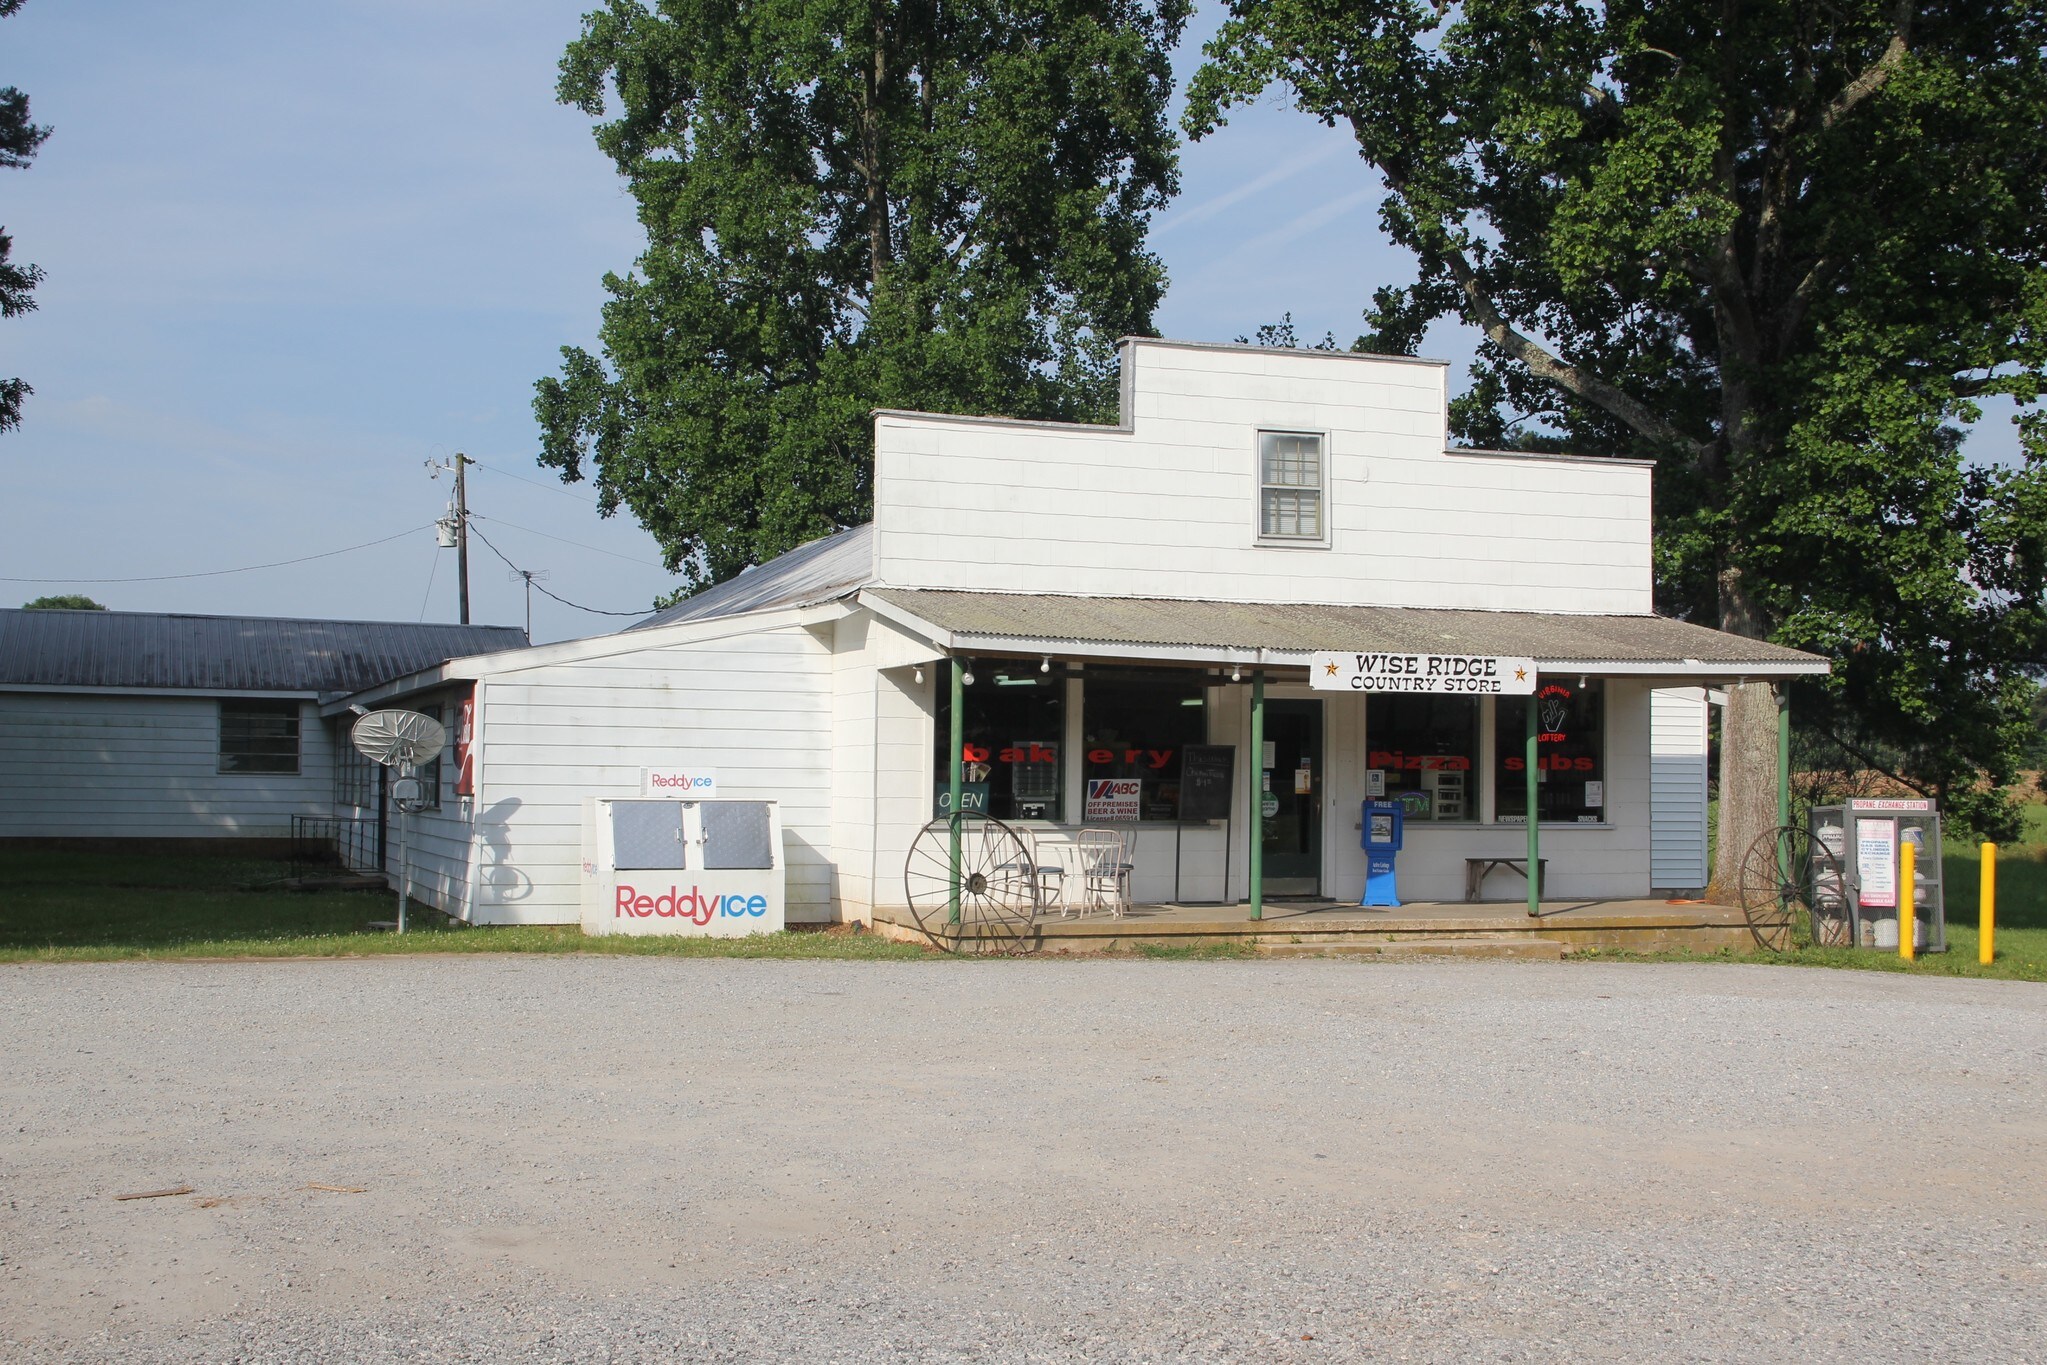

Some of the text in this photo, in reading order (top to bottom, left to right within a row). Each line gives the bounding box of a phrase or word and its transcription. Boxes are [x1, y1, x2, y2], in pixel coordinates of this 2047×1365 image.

[1355, 654, 1497, 677] WISE RIDGE
[1350, 675, 1502, 693] COUNTRY STORE
[1538, 685, 1571, 699] VIRGINIA
[1537, 733, 1567, 743] LOTTERY
[1368, 751, 1472, 771] Pizza
[939, 792, 984, 808] OEN
[1853, 800, 1927, 809] PROPANE EXCHANGE STATION
[1498, 815, 1528, 823] NEWSPAPE
[1577, 815, 1598, 823] SNACKS
